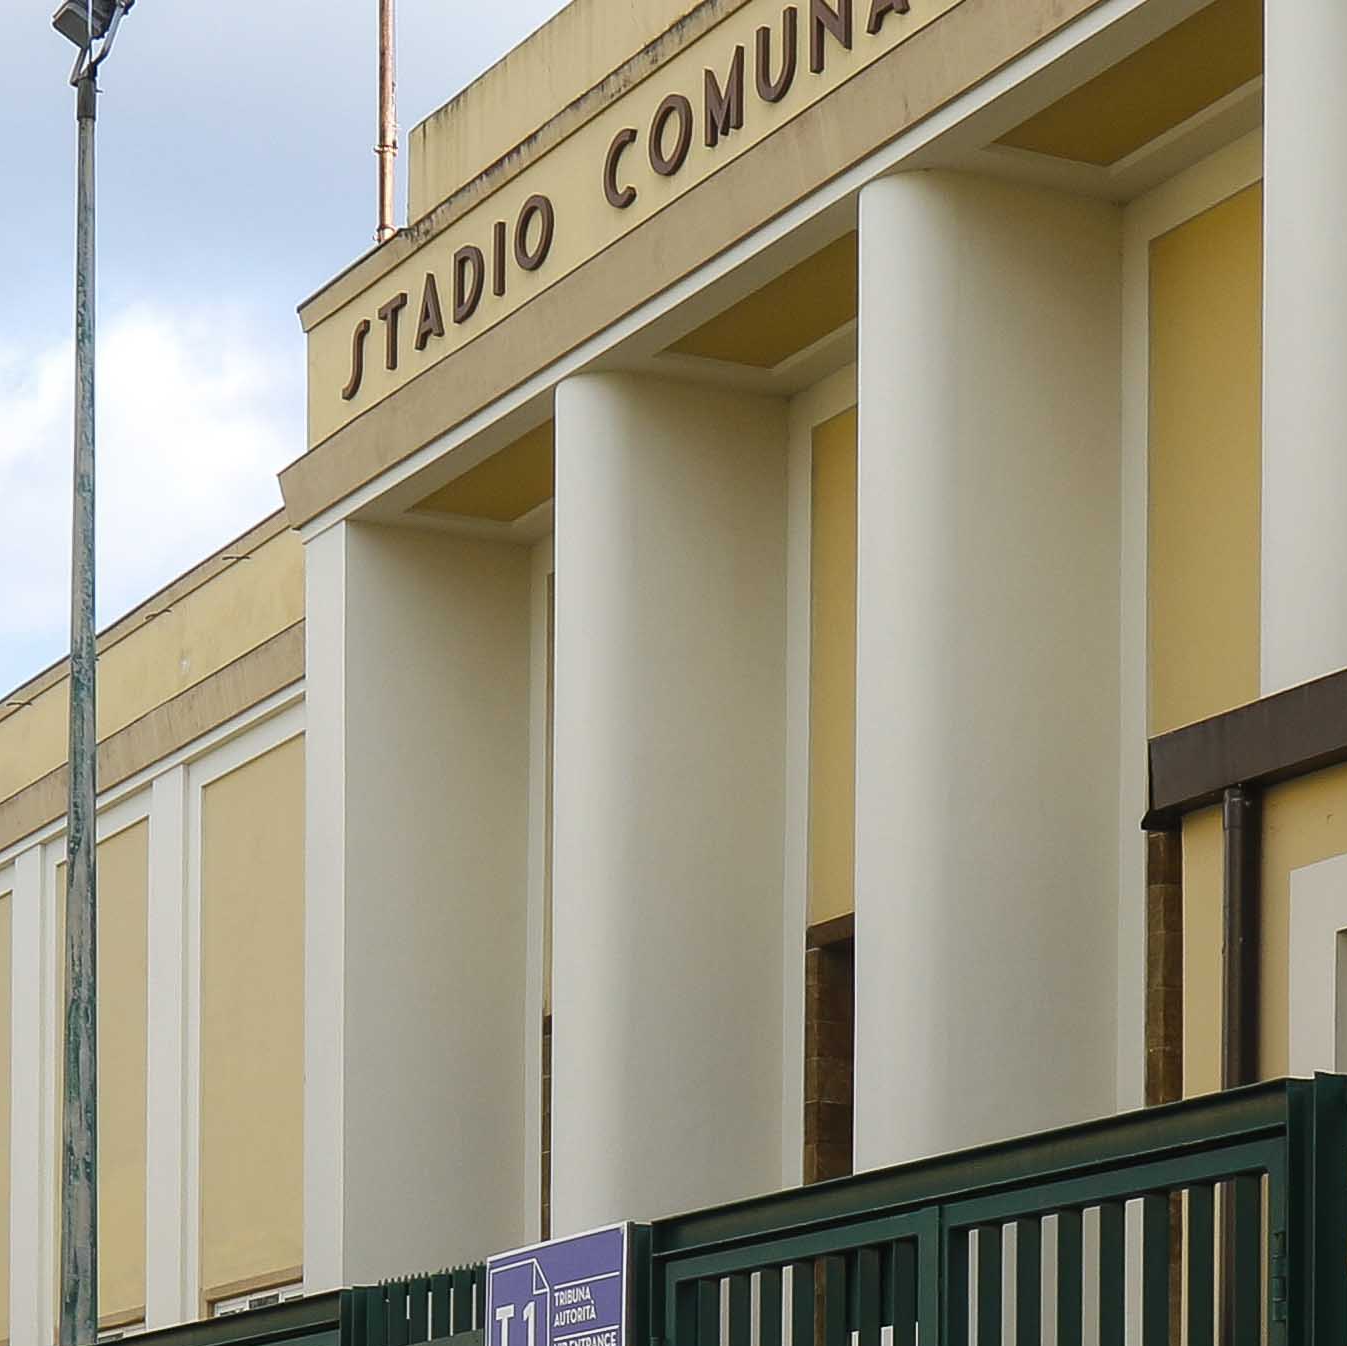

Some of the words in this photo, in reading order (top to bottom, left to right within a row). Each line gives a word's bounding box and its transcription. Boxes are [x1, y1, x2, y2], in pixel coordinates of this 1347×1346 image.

[342, 193, 554, 401] STADIO
[553, 1285, 591, 1307] TRIBUNA
[553, 1299, 597, 1328] AUTORITÀ
